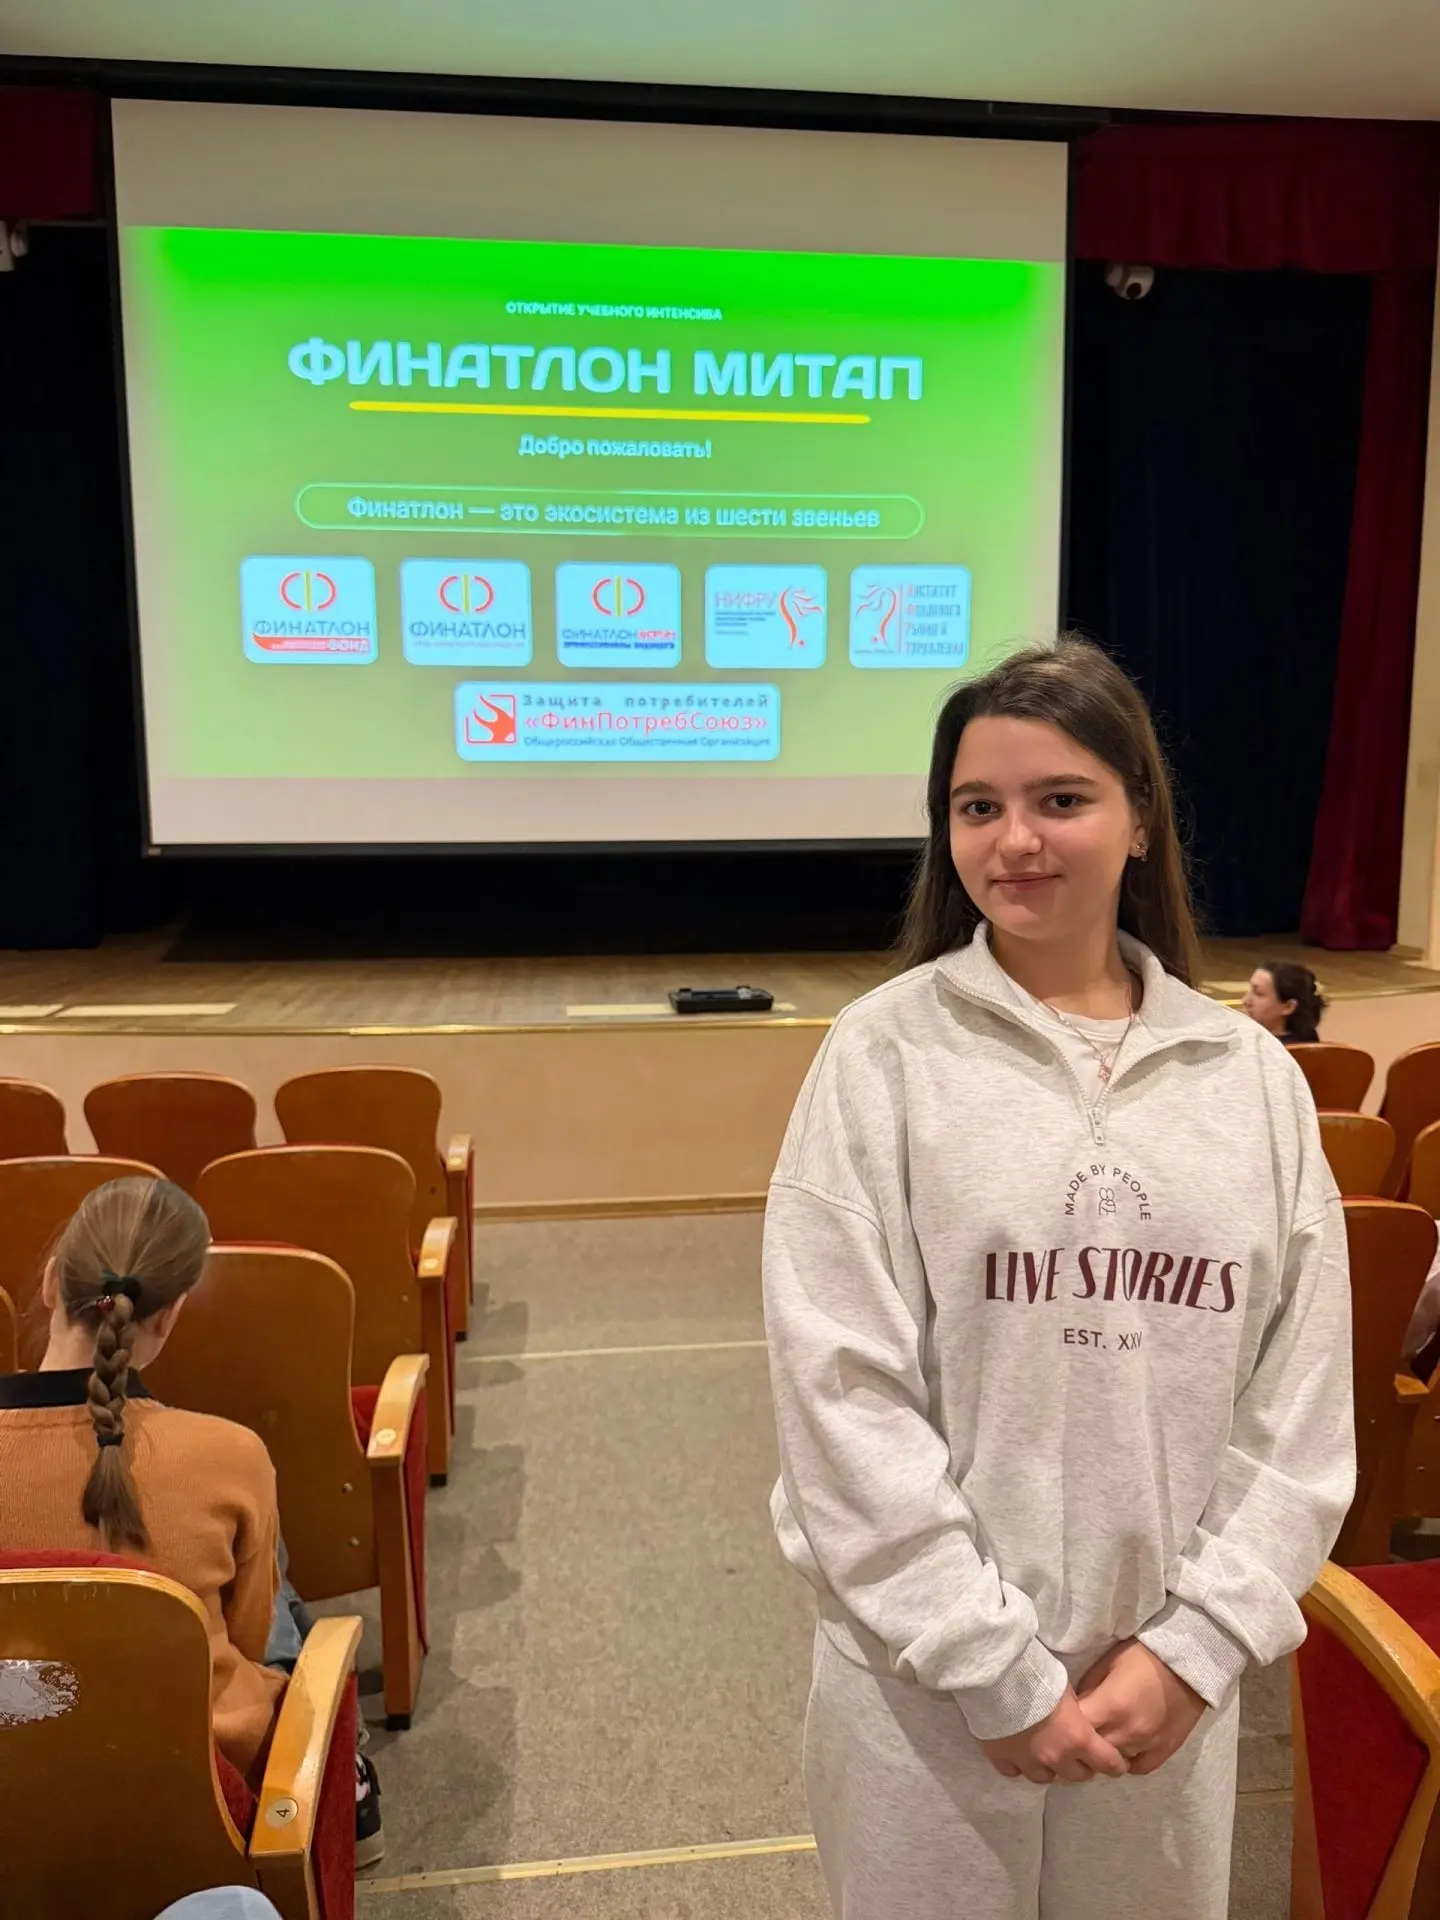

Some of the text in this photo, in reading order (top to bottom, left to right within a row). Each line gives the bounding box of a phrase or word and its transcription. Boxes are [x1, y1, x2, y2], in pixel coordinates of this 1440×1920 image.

[505, 301, 722, 320] ОТКРЫТИЕ УЧЕБНОГО ИНТЕНСИВА
[288, 336, 923, 400] ФИНАТЛОН МИТАП
[518, 433, 712, 459] Добро пожаловать!
[347, 495, 464, 521] Финатлон
[500, 501, 539, 522] это
[544, 503, 678, 525] экосистема
[684, 508, 710, 526] из
[716, 506, 786, 527] шести
[792, 507, 880, 529] звеньев
[254, 620, 371, 637] ФИНАТЛОН
[410, 621, 526, 639] ФИНАТЛОН
[523, 694, 769, 710] Защита потребителей
[525, 711, 767, 735] «ФинПотребСоюз»
[1064, 1163, 1152, 1221] MADE BY PEOPLE
[985, 1246, 1242, 1314] LIVE STORIES
[1063, 1328, 1107, 1350] EST.
[275, 1807, 290, 1818] 4
